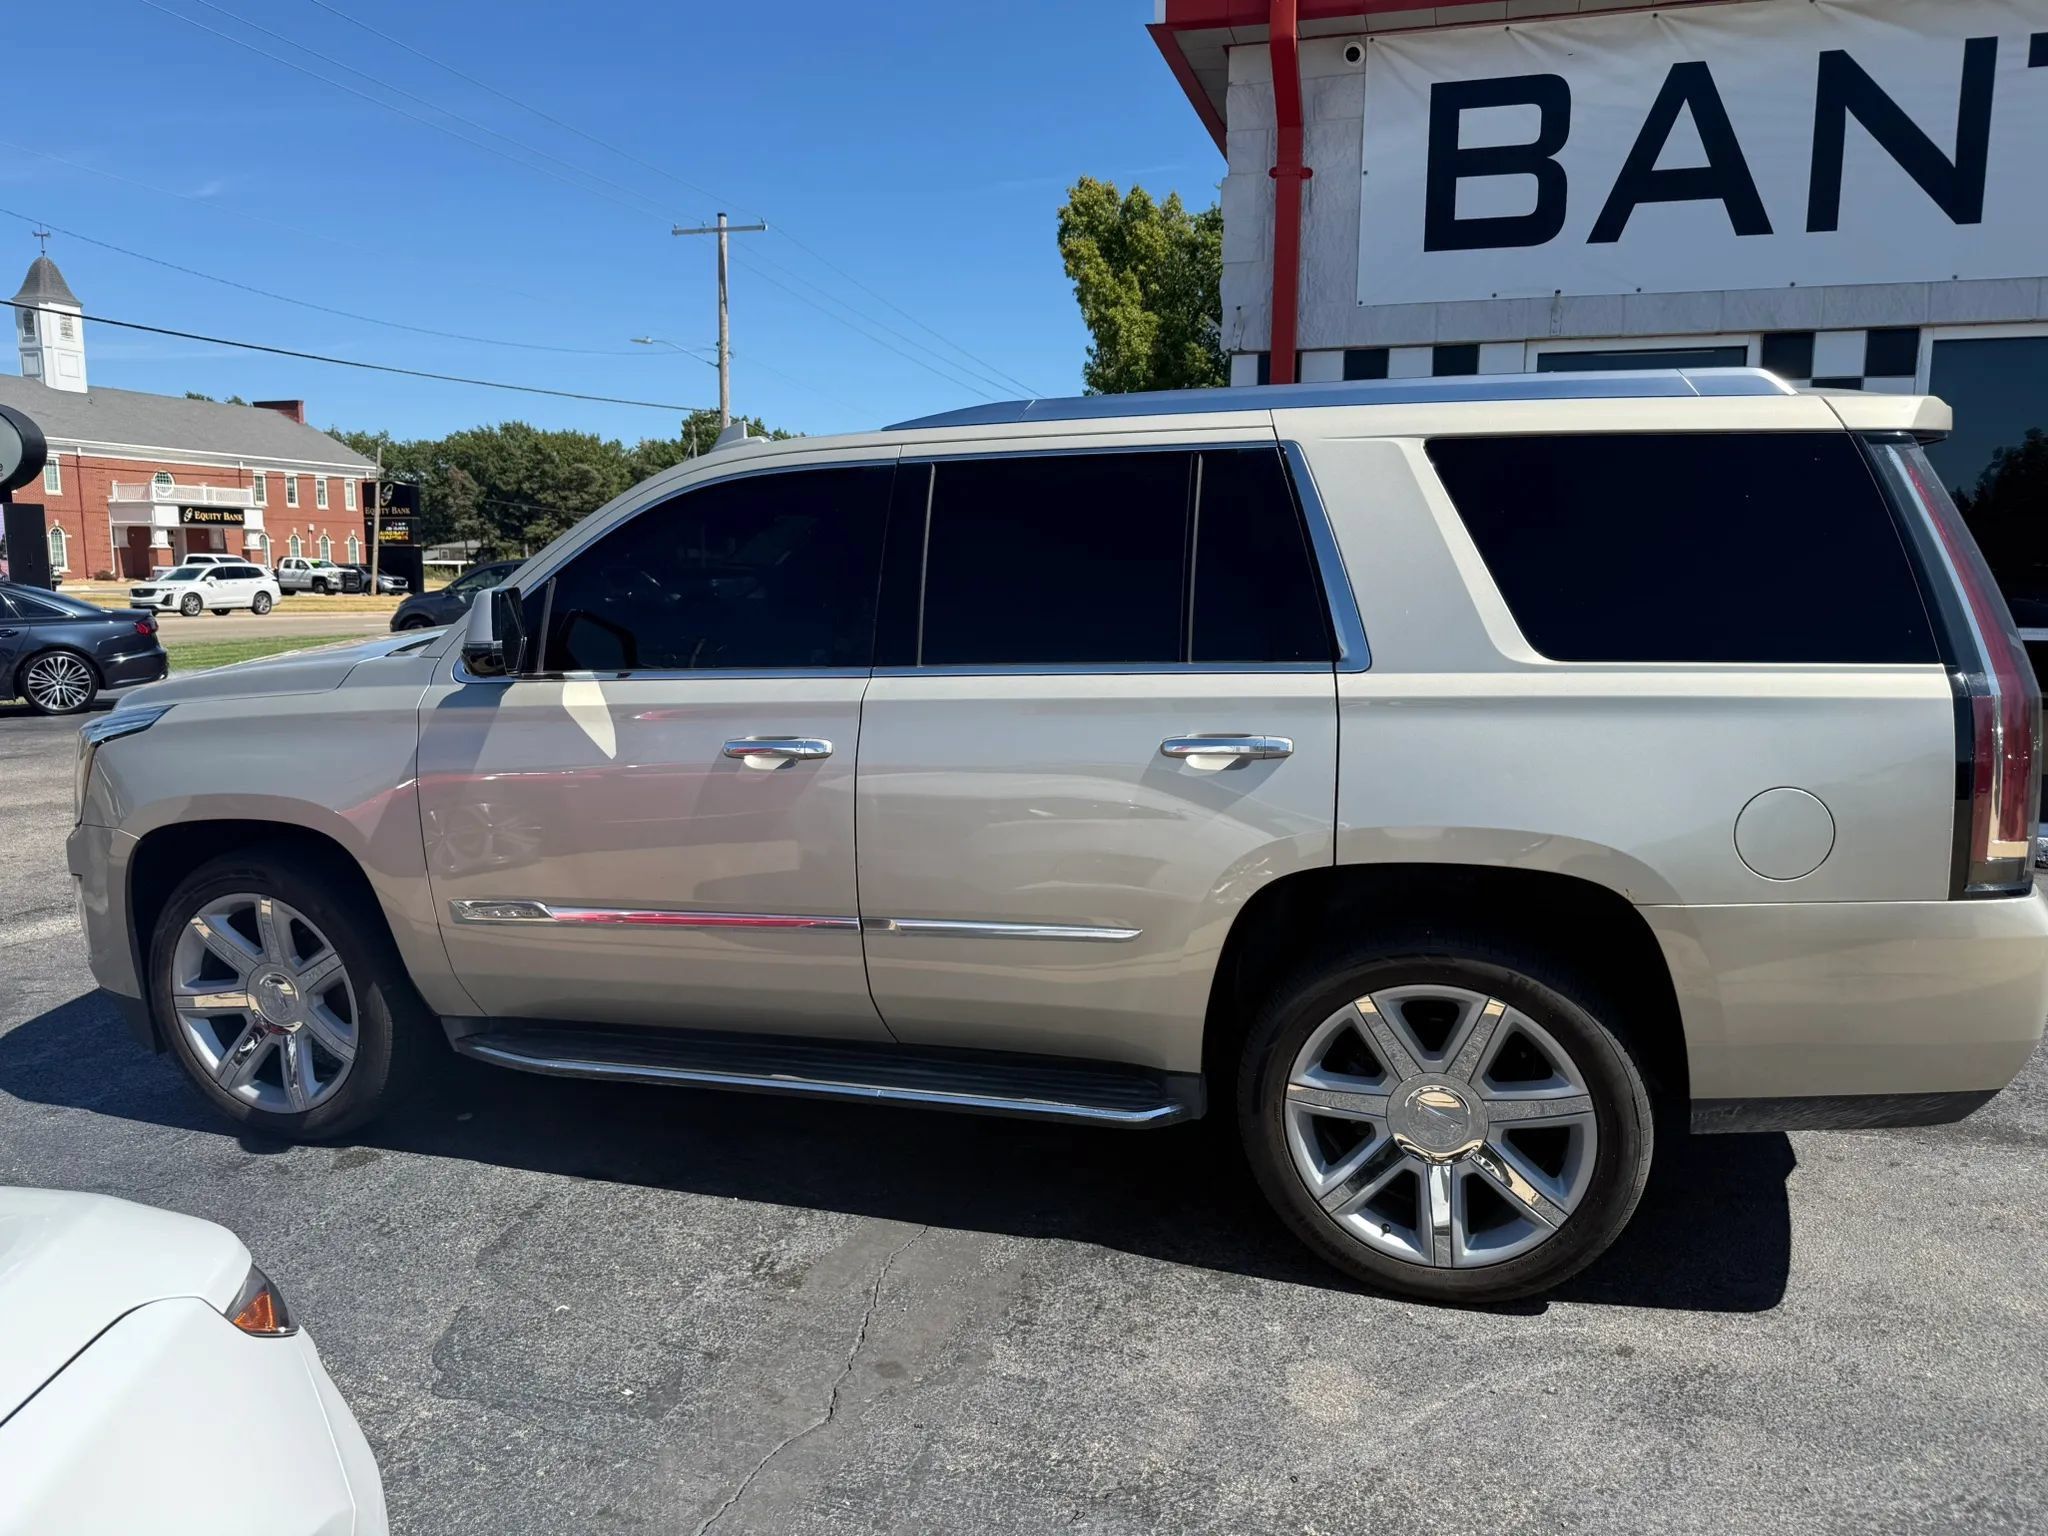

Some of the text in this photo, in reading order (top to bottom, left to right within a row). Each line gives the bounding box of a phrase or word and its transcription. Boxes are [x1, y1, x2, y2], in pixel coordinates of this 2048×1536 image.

[1424, 33, 2048, 252] BAN
[194, 510, 244, 521] EQUITY BANK
